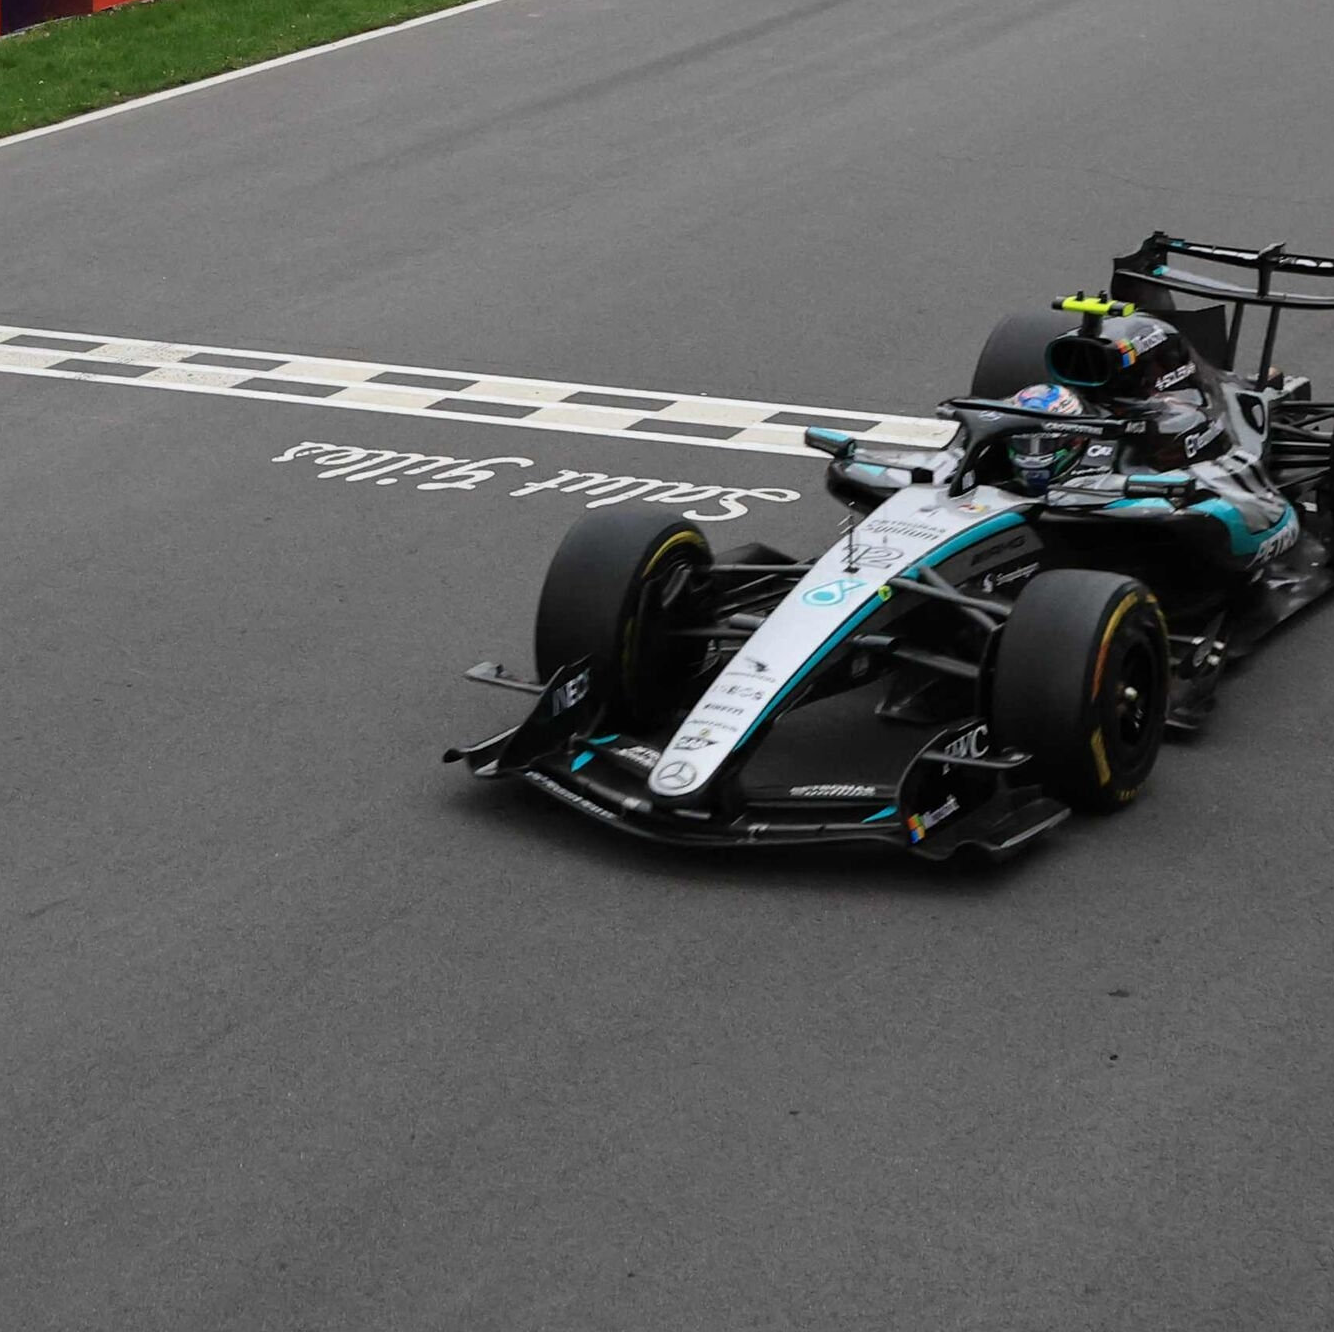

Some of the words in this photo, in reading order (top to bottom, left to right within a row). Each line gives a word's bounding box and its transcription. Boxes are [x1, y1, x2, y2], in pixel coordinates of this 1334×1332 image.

[271, 440, 535, 492] Gilles
[508, 468, 802, 522] Salut
[840, 543, 904, 569] 12
